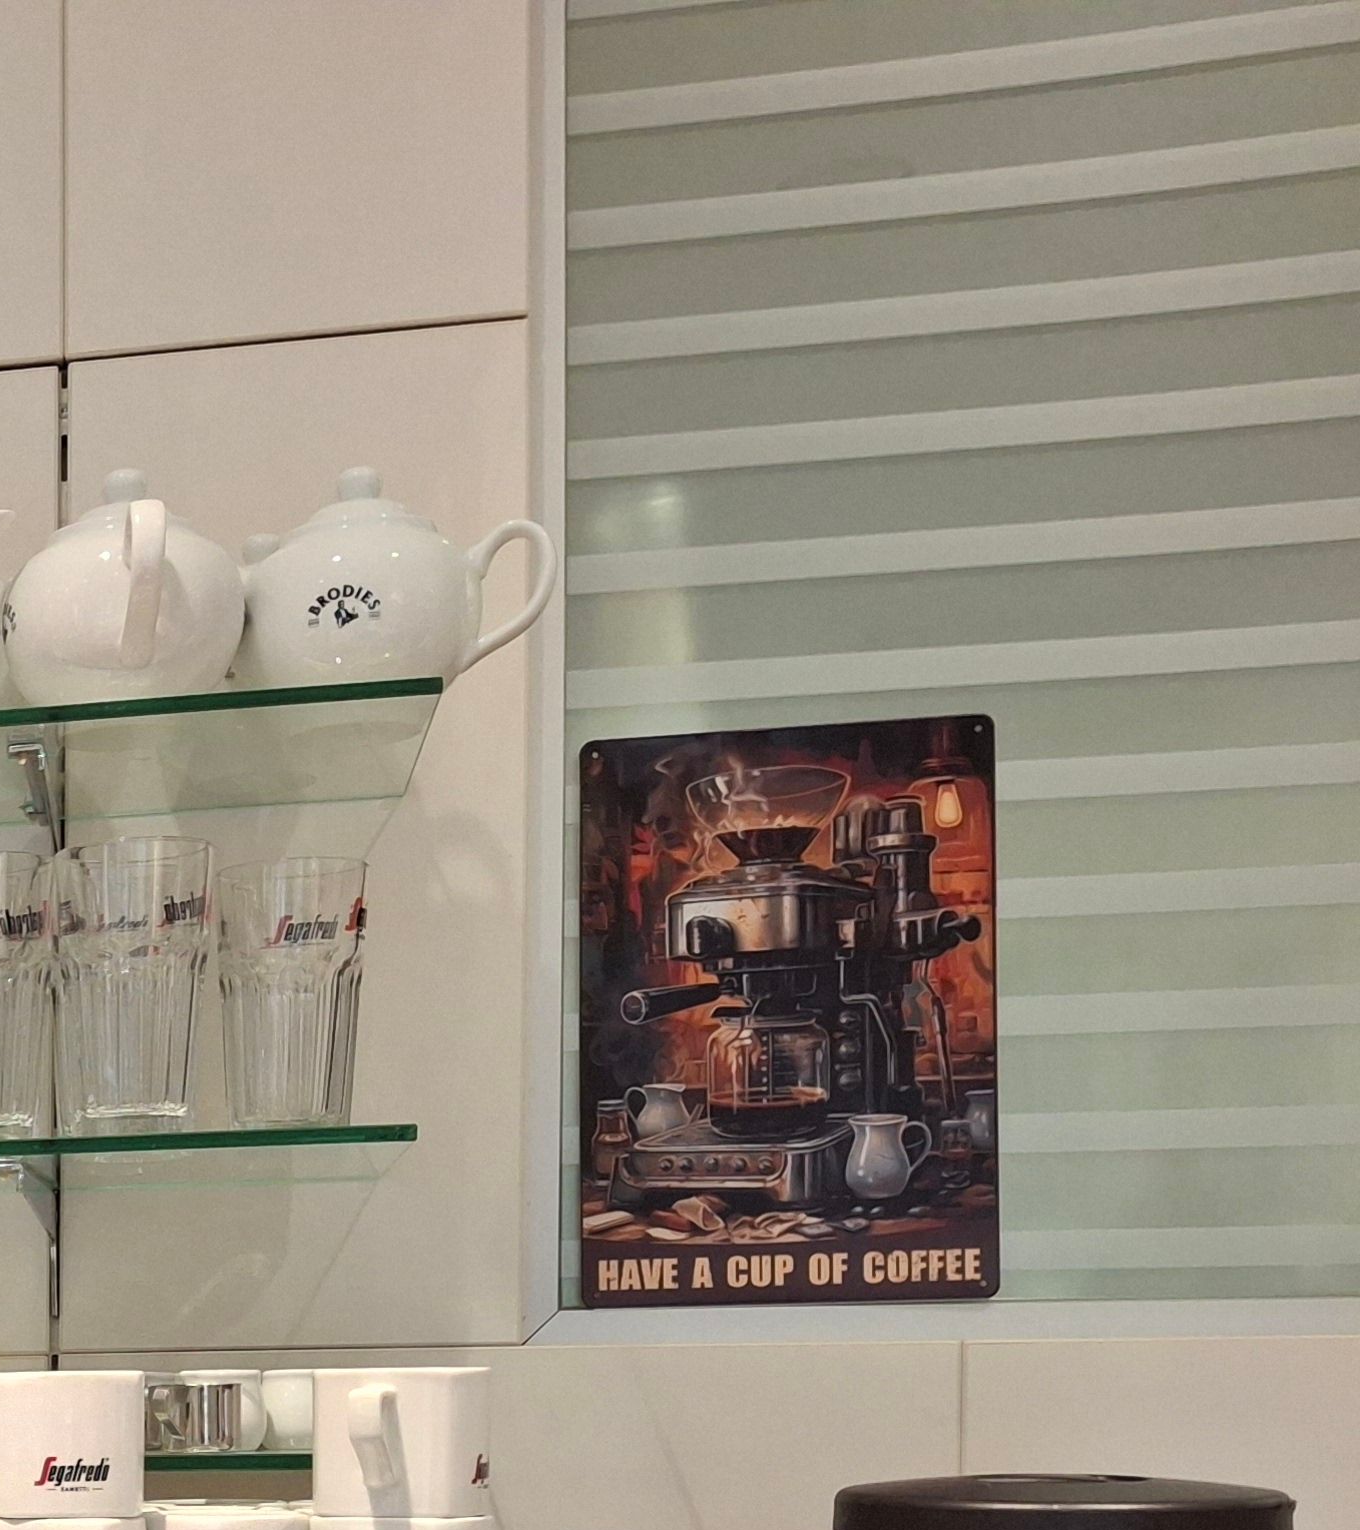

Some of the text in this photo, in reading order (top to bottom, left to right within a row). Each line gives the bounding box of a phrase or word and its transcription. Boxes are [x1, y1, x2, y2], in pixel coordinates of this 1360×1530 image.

[308, 584, 381, 617] BRODIES
[598, 1248, 982, 1292] HAVE A CUP OF COFFEE
[34, 1456, 111, 1487] Segafredo
